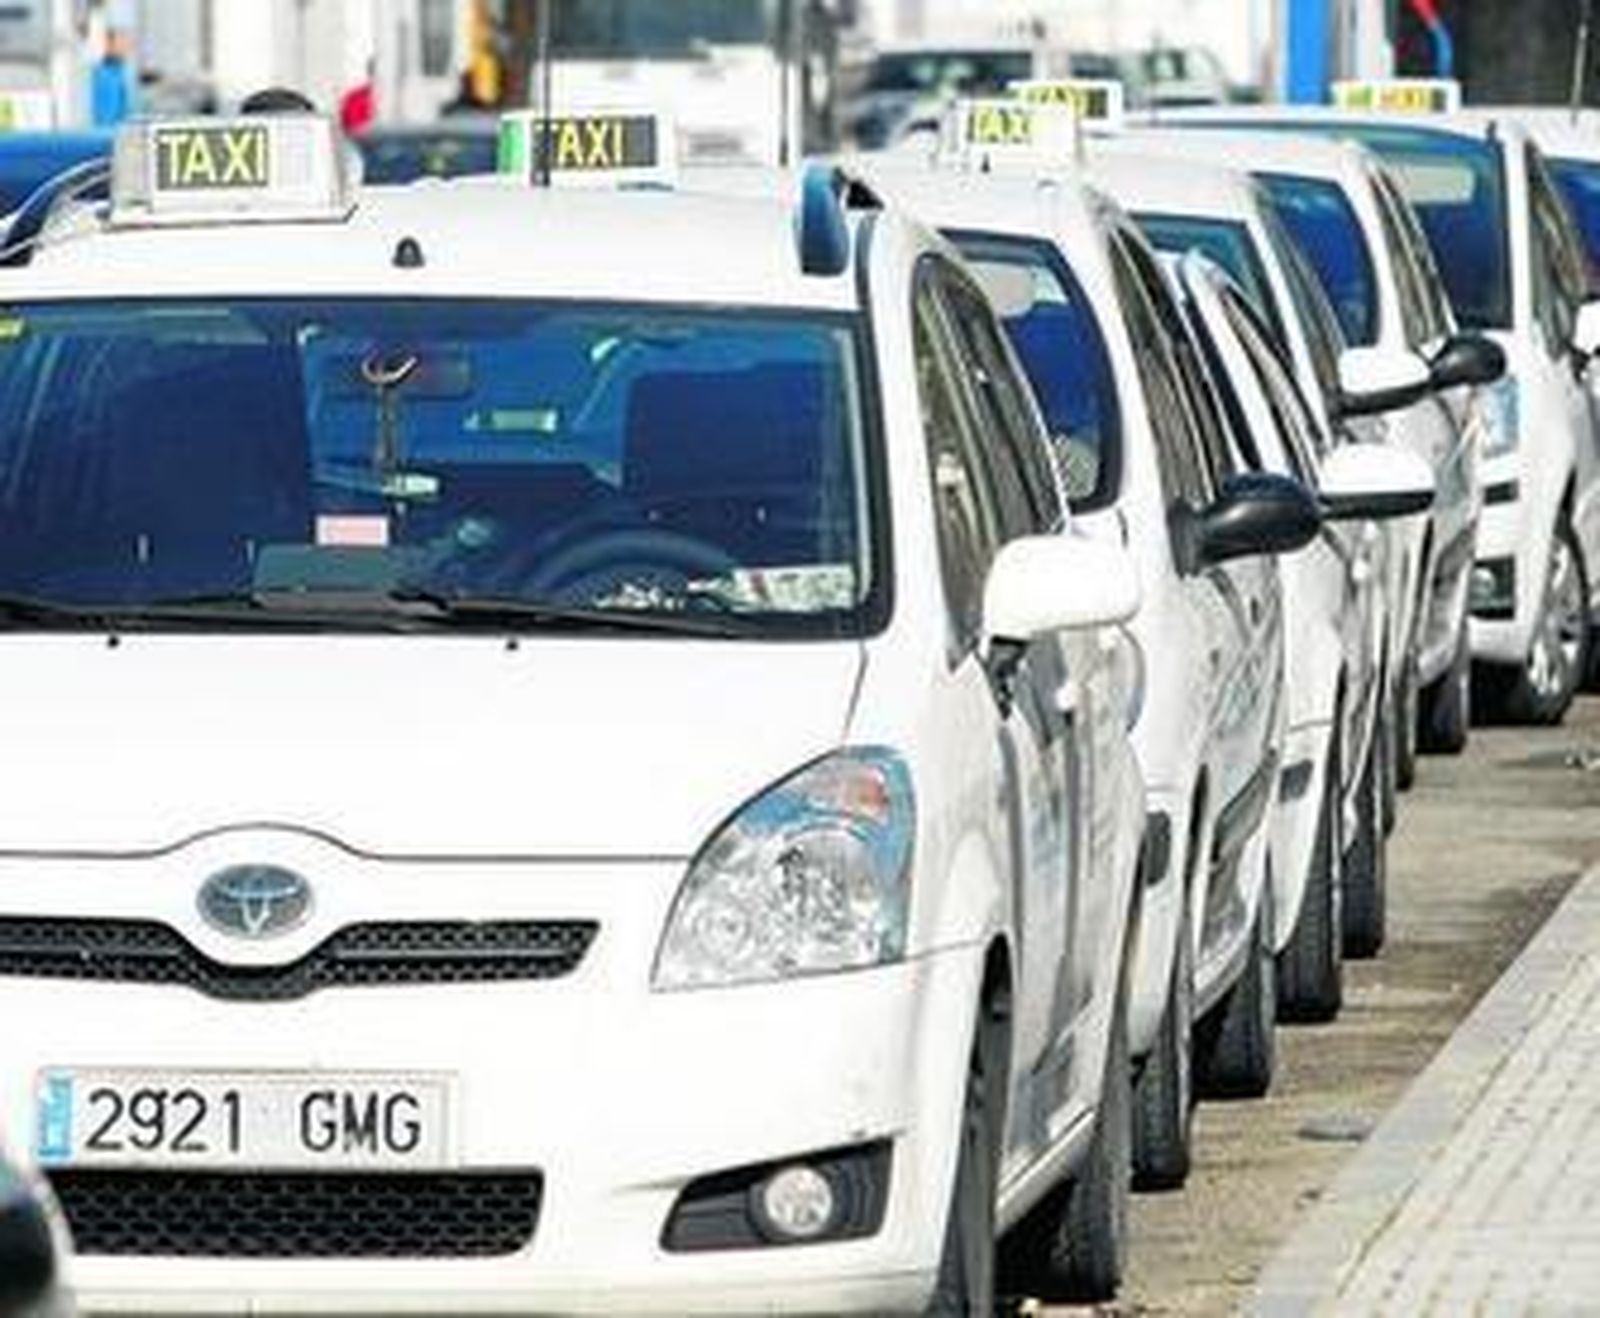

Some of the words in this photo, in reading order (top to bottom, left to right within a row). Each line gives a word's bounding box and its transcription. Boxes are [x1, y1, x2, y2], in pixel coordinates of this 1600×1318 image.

[160, 130, 265, 184] TAXI
[84, 1087, 241, 1152] 2921
[299, 1089, 422, 1154] GMG
